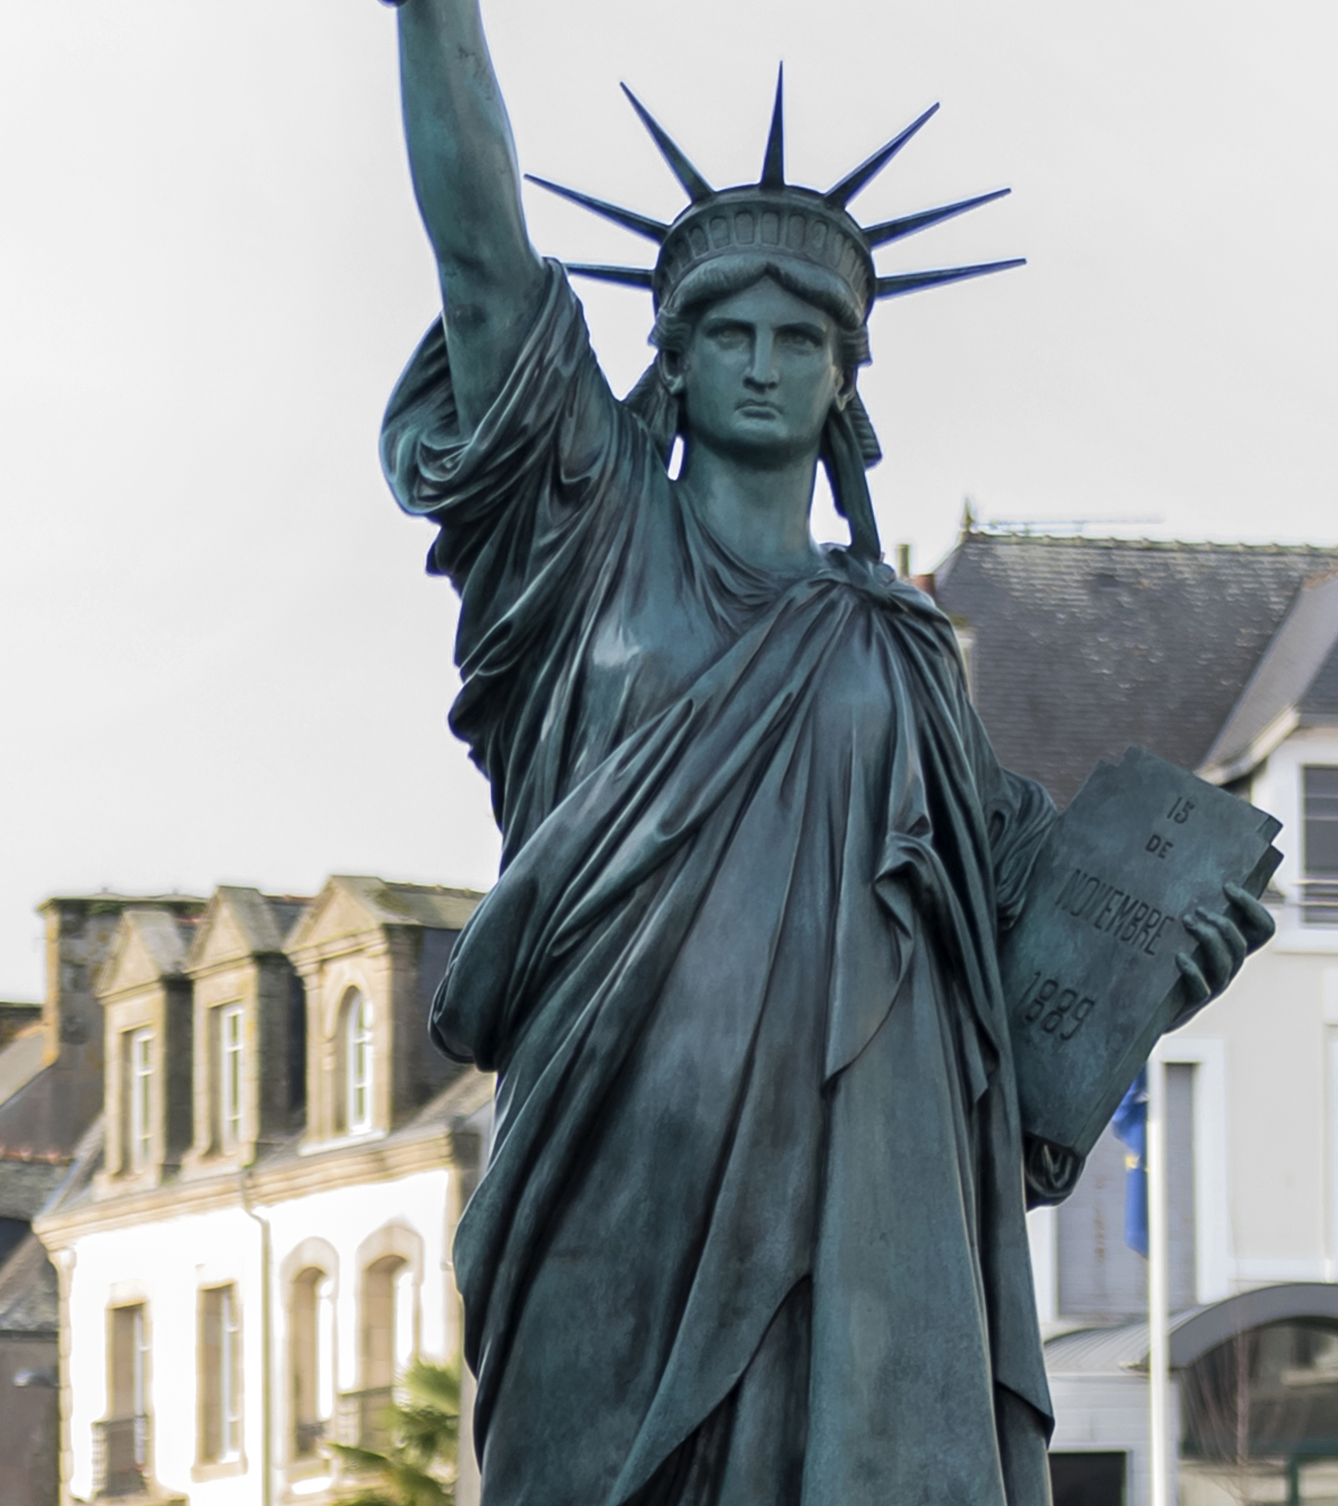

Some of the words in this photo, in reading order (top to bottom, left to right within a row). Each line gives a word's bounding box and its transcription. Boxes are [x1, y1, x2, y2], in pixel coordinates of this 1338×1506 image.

[1145, 834, 1174, 859] DE
[1055, 868, 1175, 956] NOVEMBRE
[1017, 971, 1095, 1041] 1889
